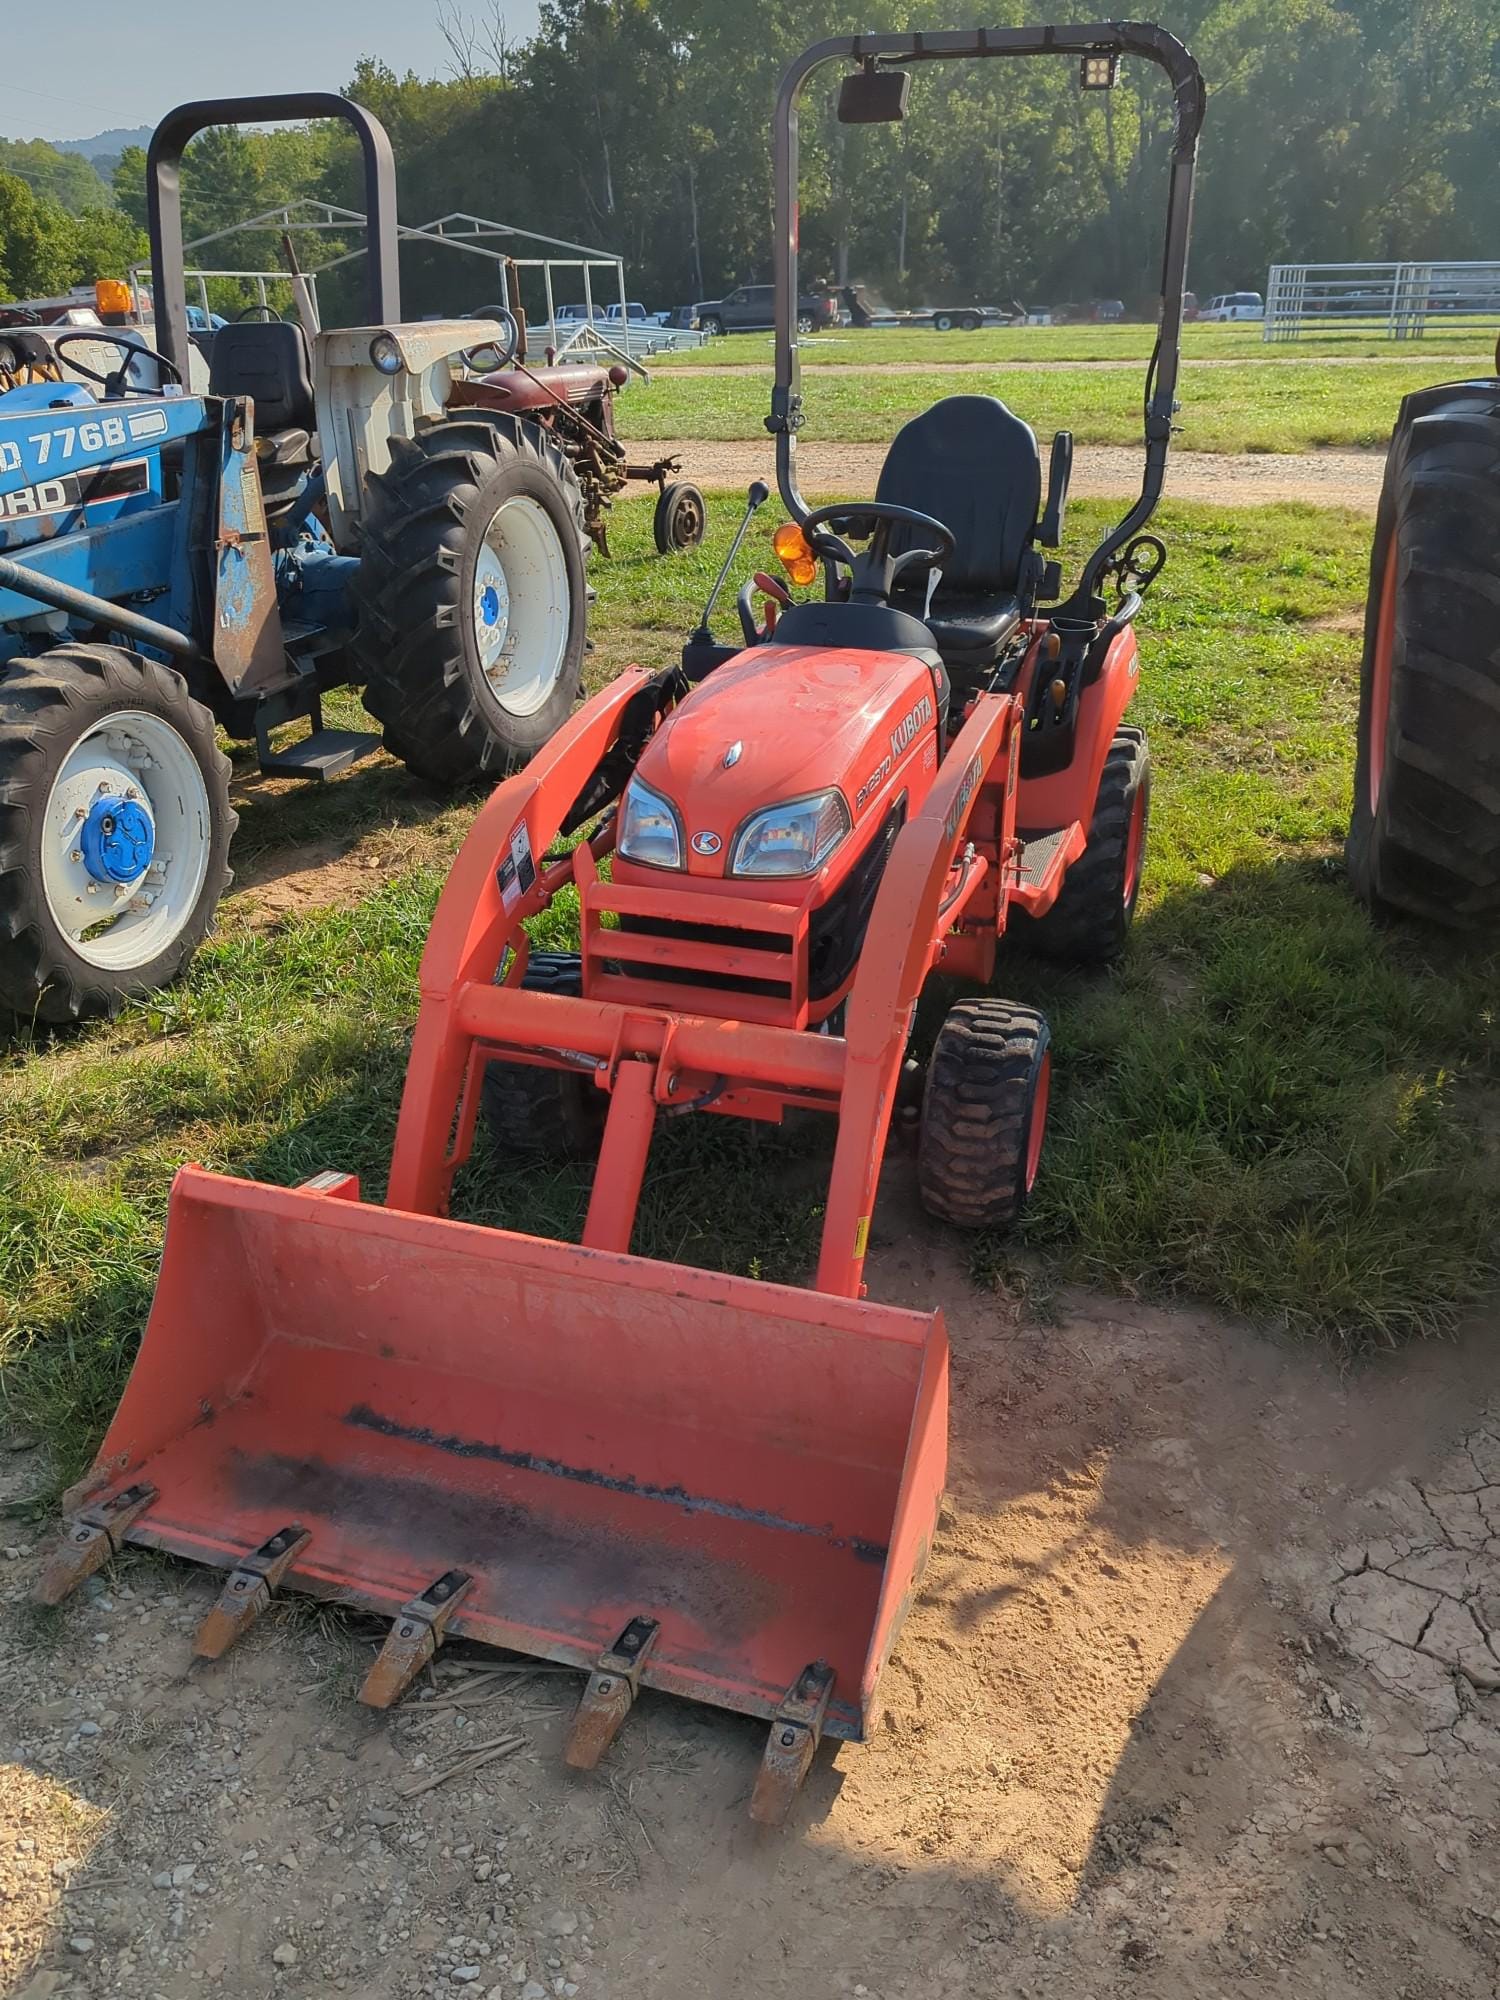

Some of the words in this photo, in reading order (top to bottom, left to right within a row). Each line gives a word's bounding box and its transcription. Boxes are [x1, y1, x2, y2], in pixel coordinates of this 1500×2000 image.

[28, 417, 127, 465] 776B
[0, 480, 66, 516] RD
[890, 695, 932, 760] KUBOTA
